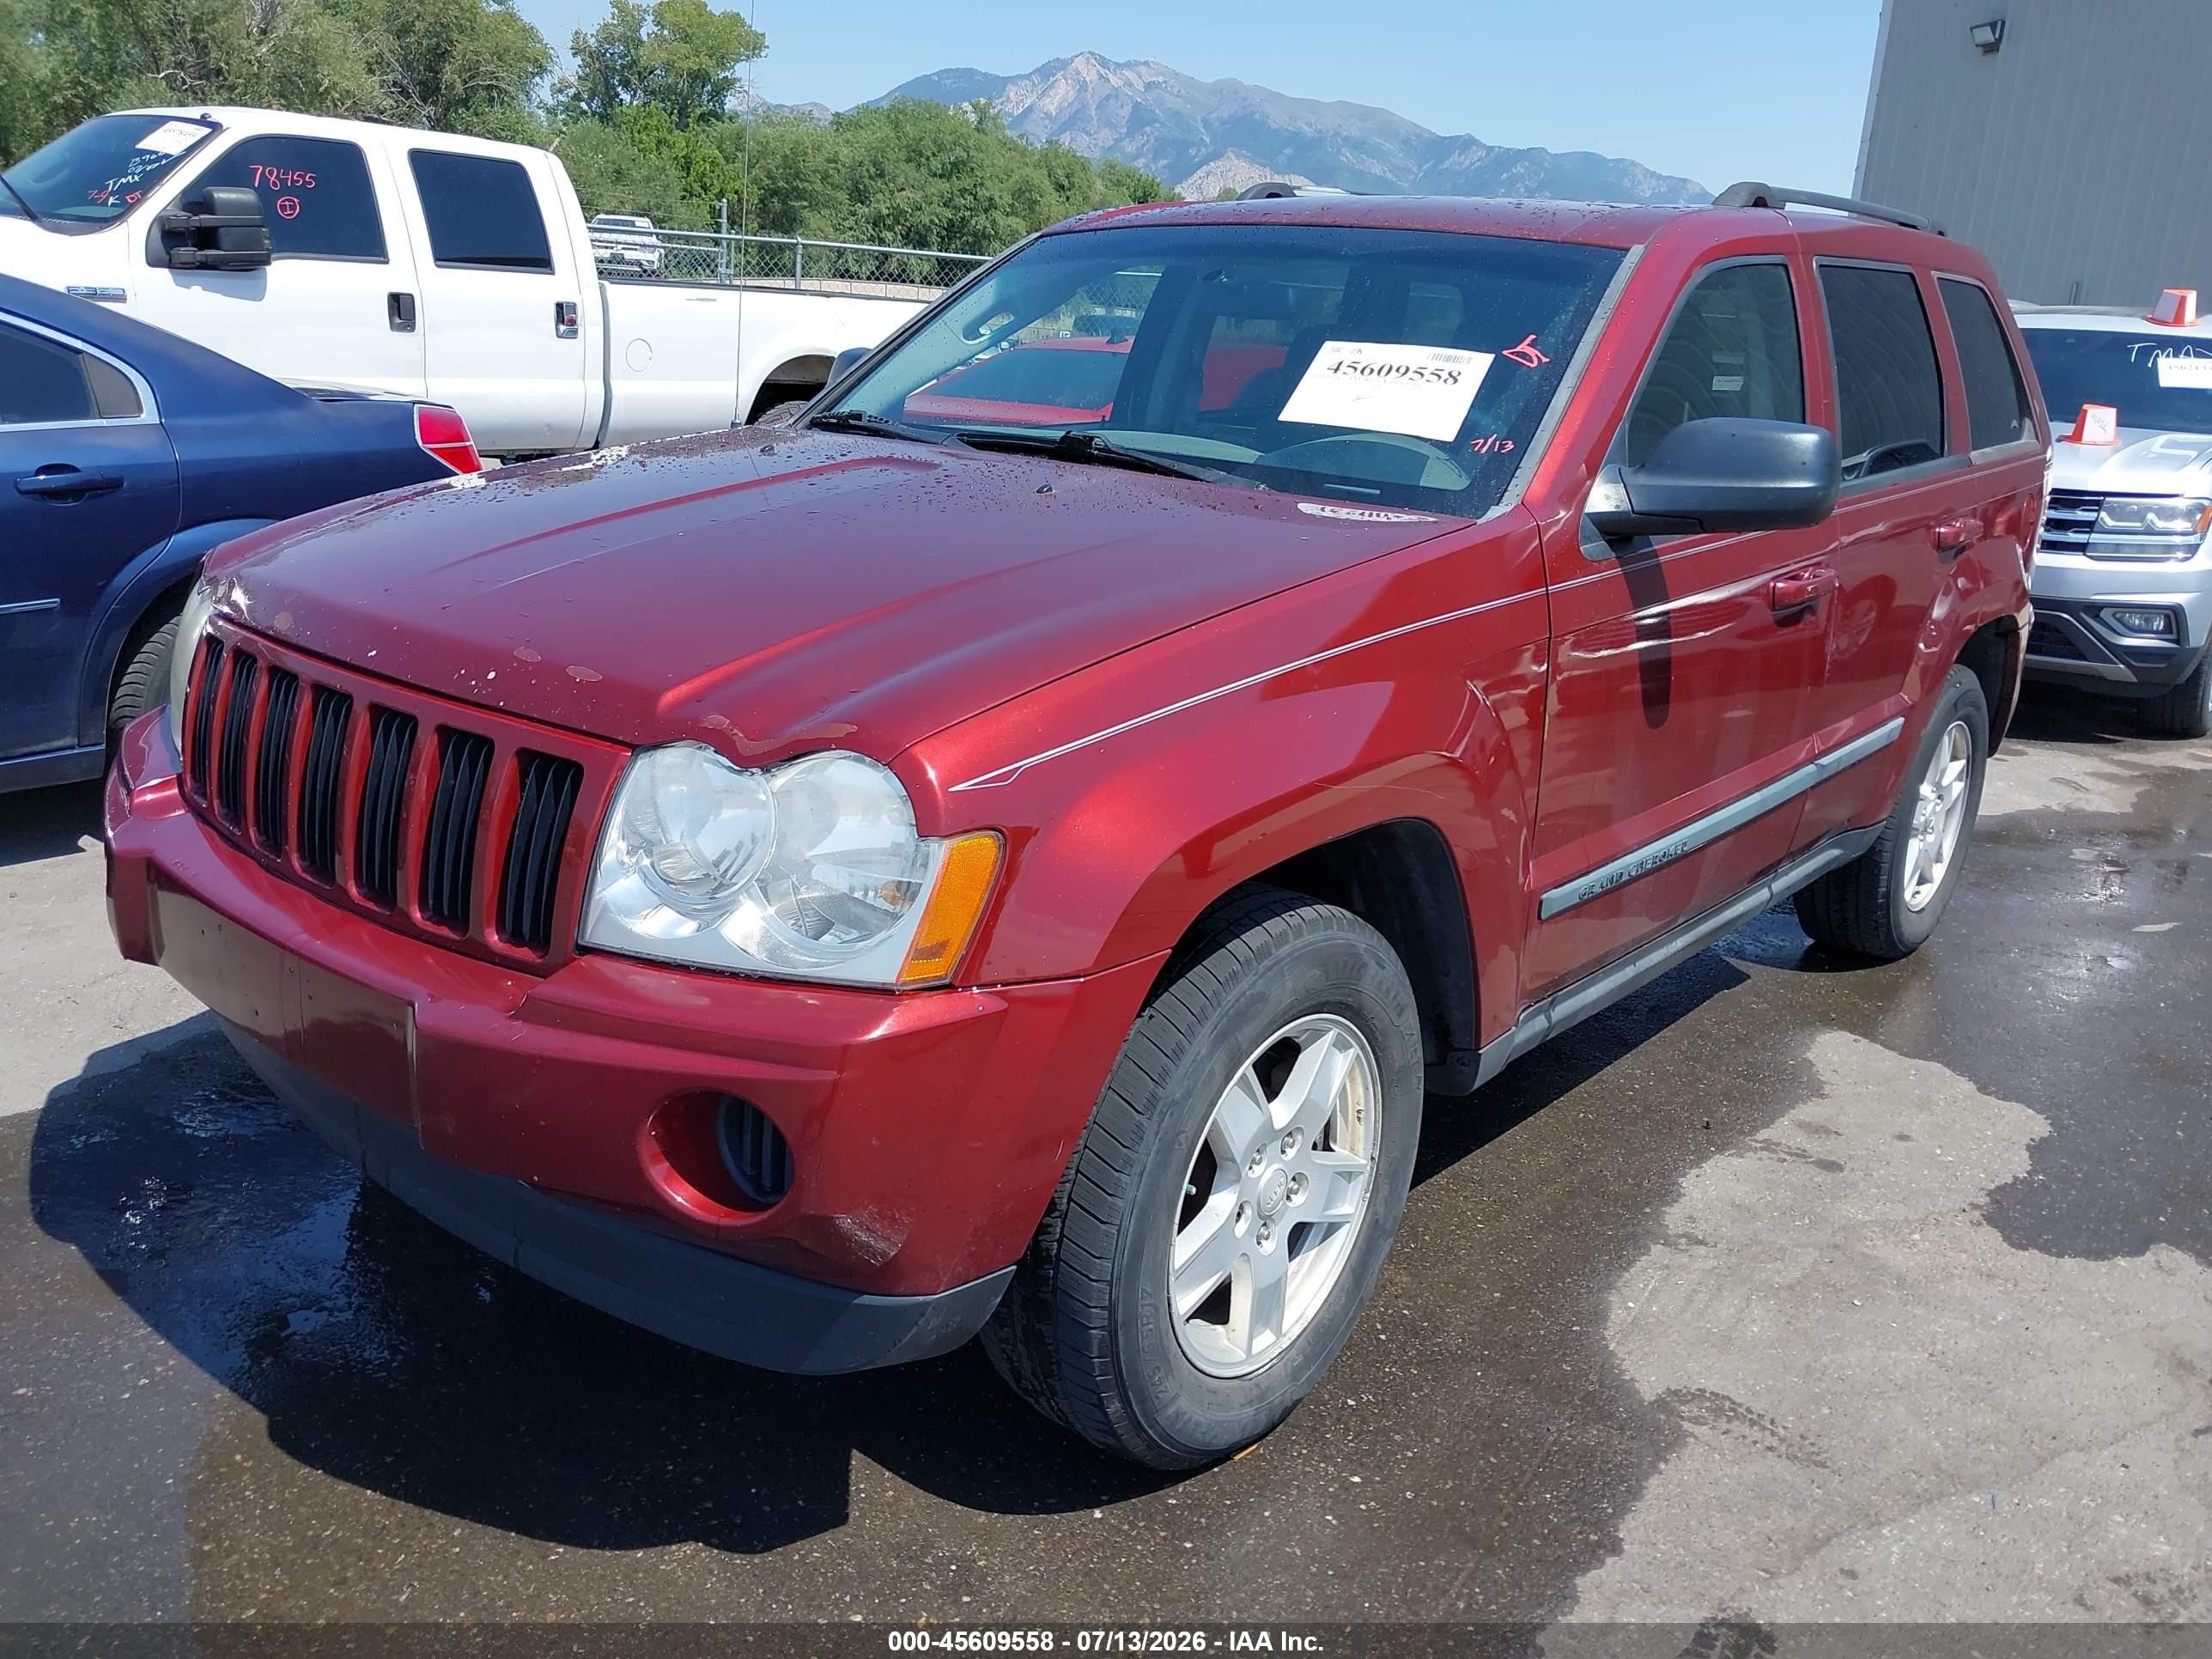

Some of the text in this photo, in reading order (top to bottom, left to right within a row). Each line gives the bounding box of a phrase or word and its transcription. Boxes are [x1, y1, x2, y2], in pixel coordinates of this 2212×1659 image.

[249, 165, 317, 191] 78455
[1327, 360, 1462, 386] 45609558
[1470, 433, 1515, 454] 7/13
